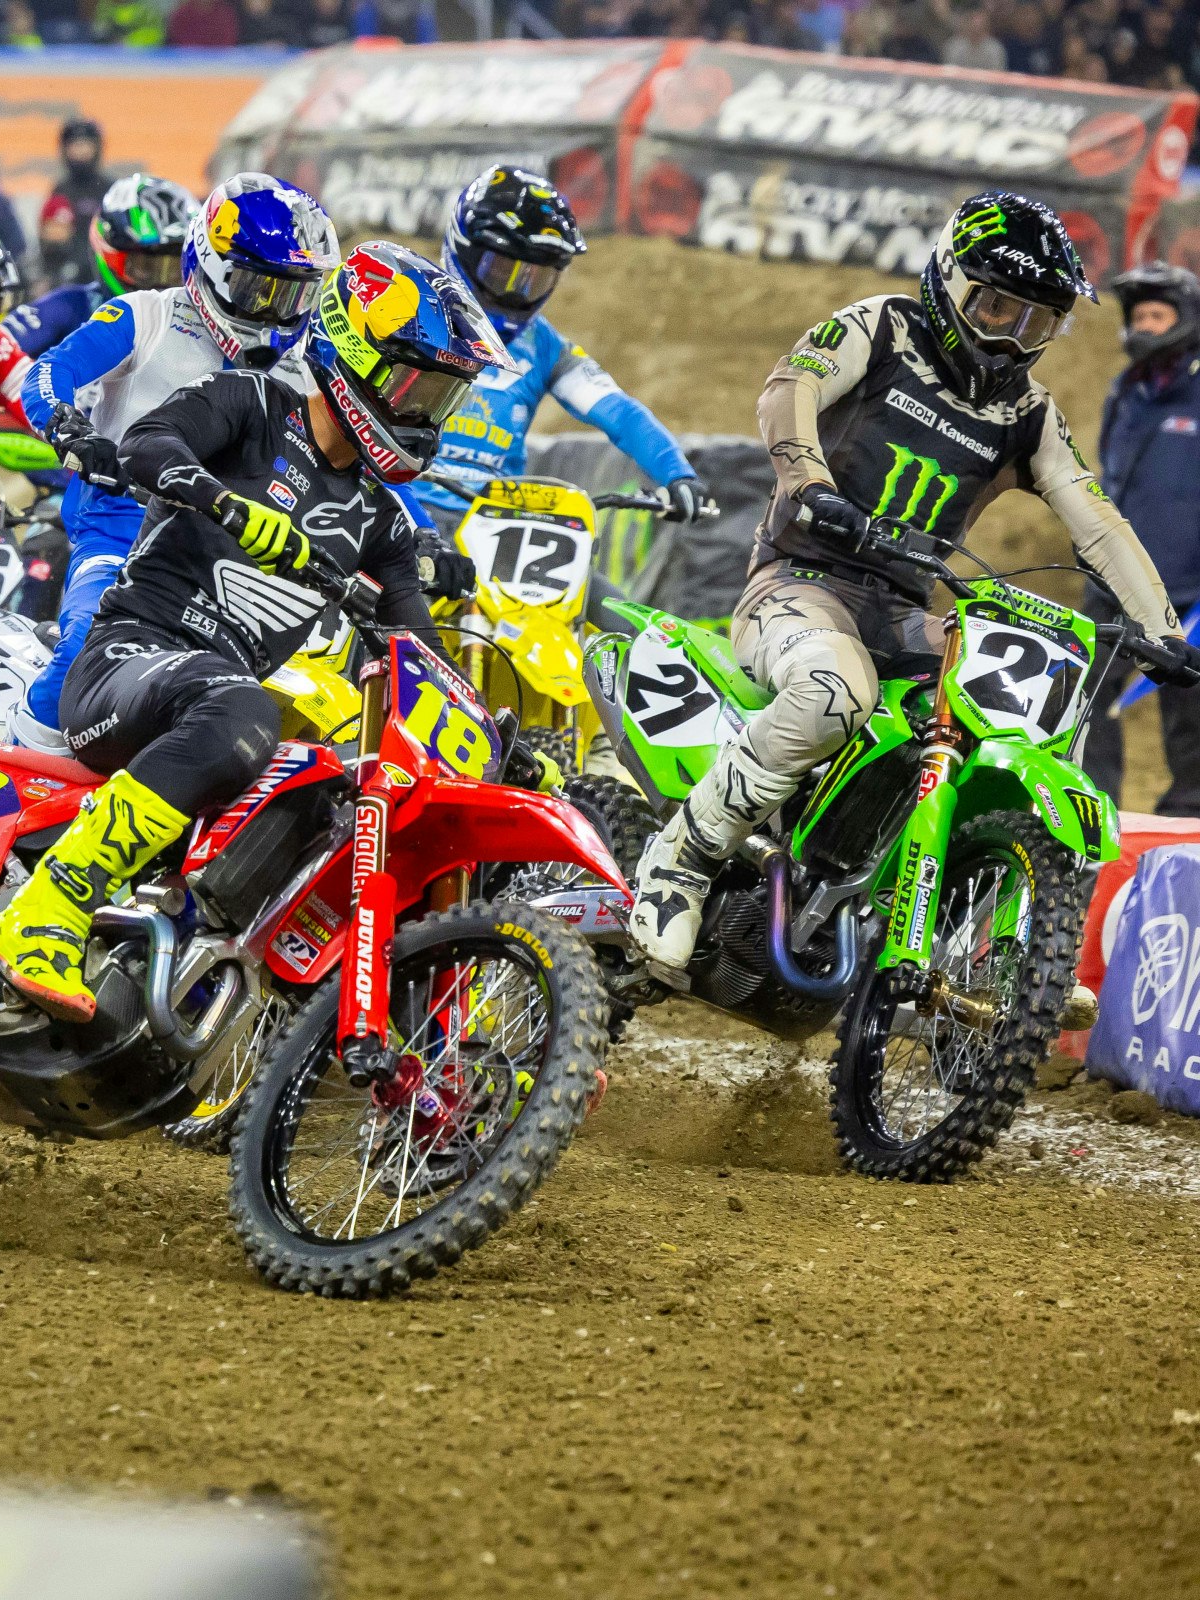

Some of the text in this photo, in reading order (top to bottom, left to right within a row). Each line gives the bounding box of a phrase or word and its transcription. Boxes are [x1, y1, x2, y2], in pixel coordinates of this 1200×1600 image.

[991, 244, 1045, 275] AIROH
[891, 393, 937, 425] AIROH
[936, 417, 998, 463] Kawasaki
[271, 484, 297, 506] 100%
[285, 471, 308, 497] LOCK
[288, 464, 311, 488] QUAD
[490, 527, 577, 591] 12
[988, 590, 1069, 627] RENTHAL
[1020, 619, 1059, 640] MONSTER
[228, 639, 250, 670] DUNLO
[627, 664, 719, 739] 21
[963, 631, 1084, 737] 21
[957, 691, 992, 730] Kawasaki
[69, 712, 120, 750] HONDA
[404, 681, 493, 780] 18
[1038, 733, 1068, 751] Kawasaki
[546, 904, 584, 917] NTHAL
[891, 838, 921, 947] DUNLOP
[910, 888, 930, 952] CARRILLO
[354, 907, 375, 1011] DUNLOP
[499, 922, 554, 969] DUNLOP
